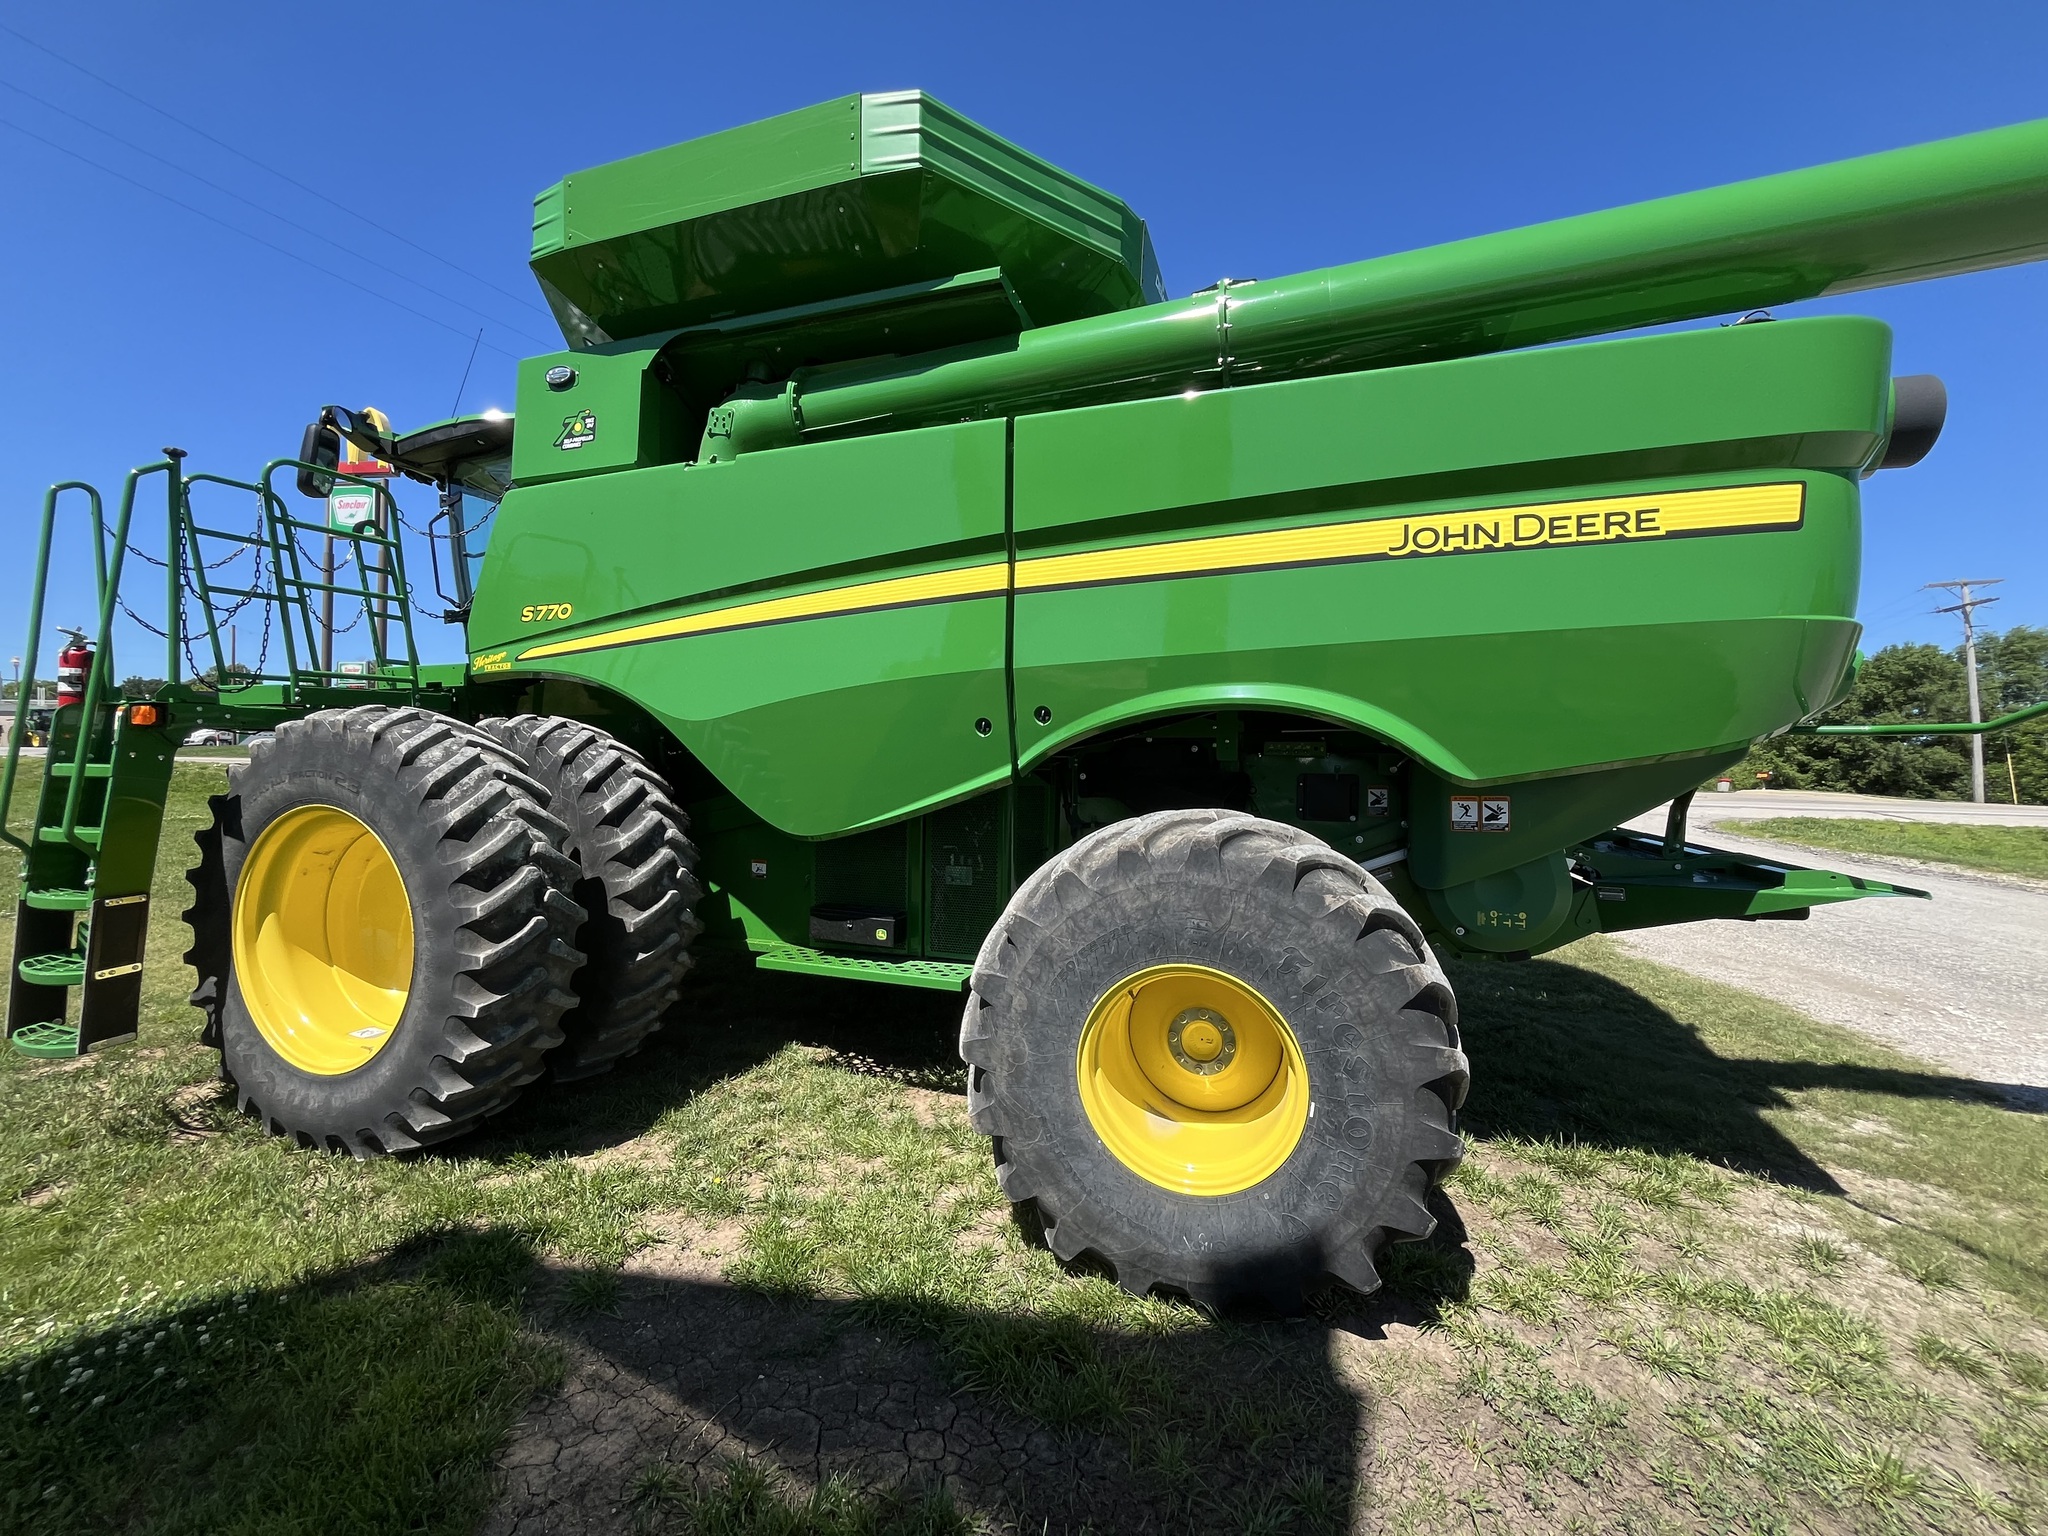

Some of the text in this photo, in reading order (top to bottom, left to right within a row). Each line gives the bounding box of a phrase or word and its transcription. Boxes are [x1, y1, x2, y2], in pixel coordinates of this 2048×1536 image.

[337, 499, 368, 510] Sinclair
[1388, 507, 1661, 552] JOHN DEERE
[521, 602, 574, 623] S770
[472, 651, 507, 671] Heritage
[1276, 946, 1376, 1212] Firestone
